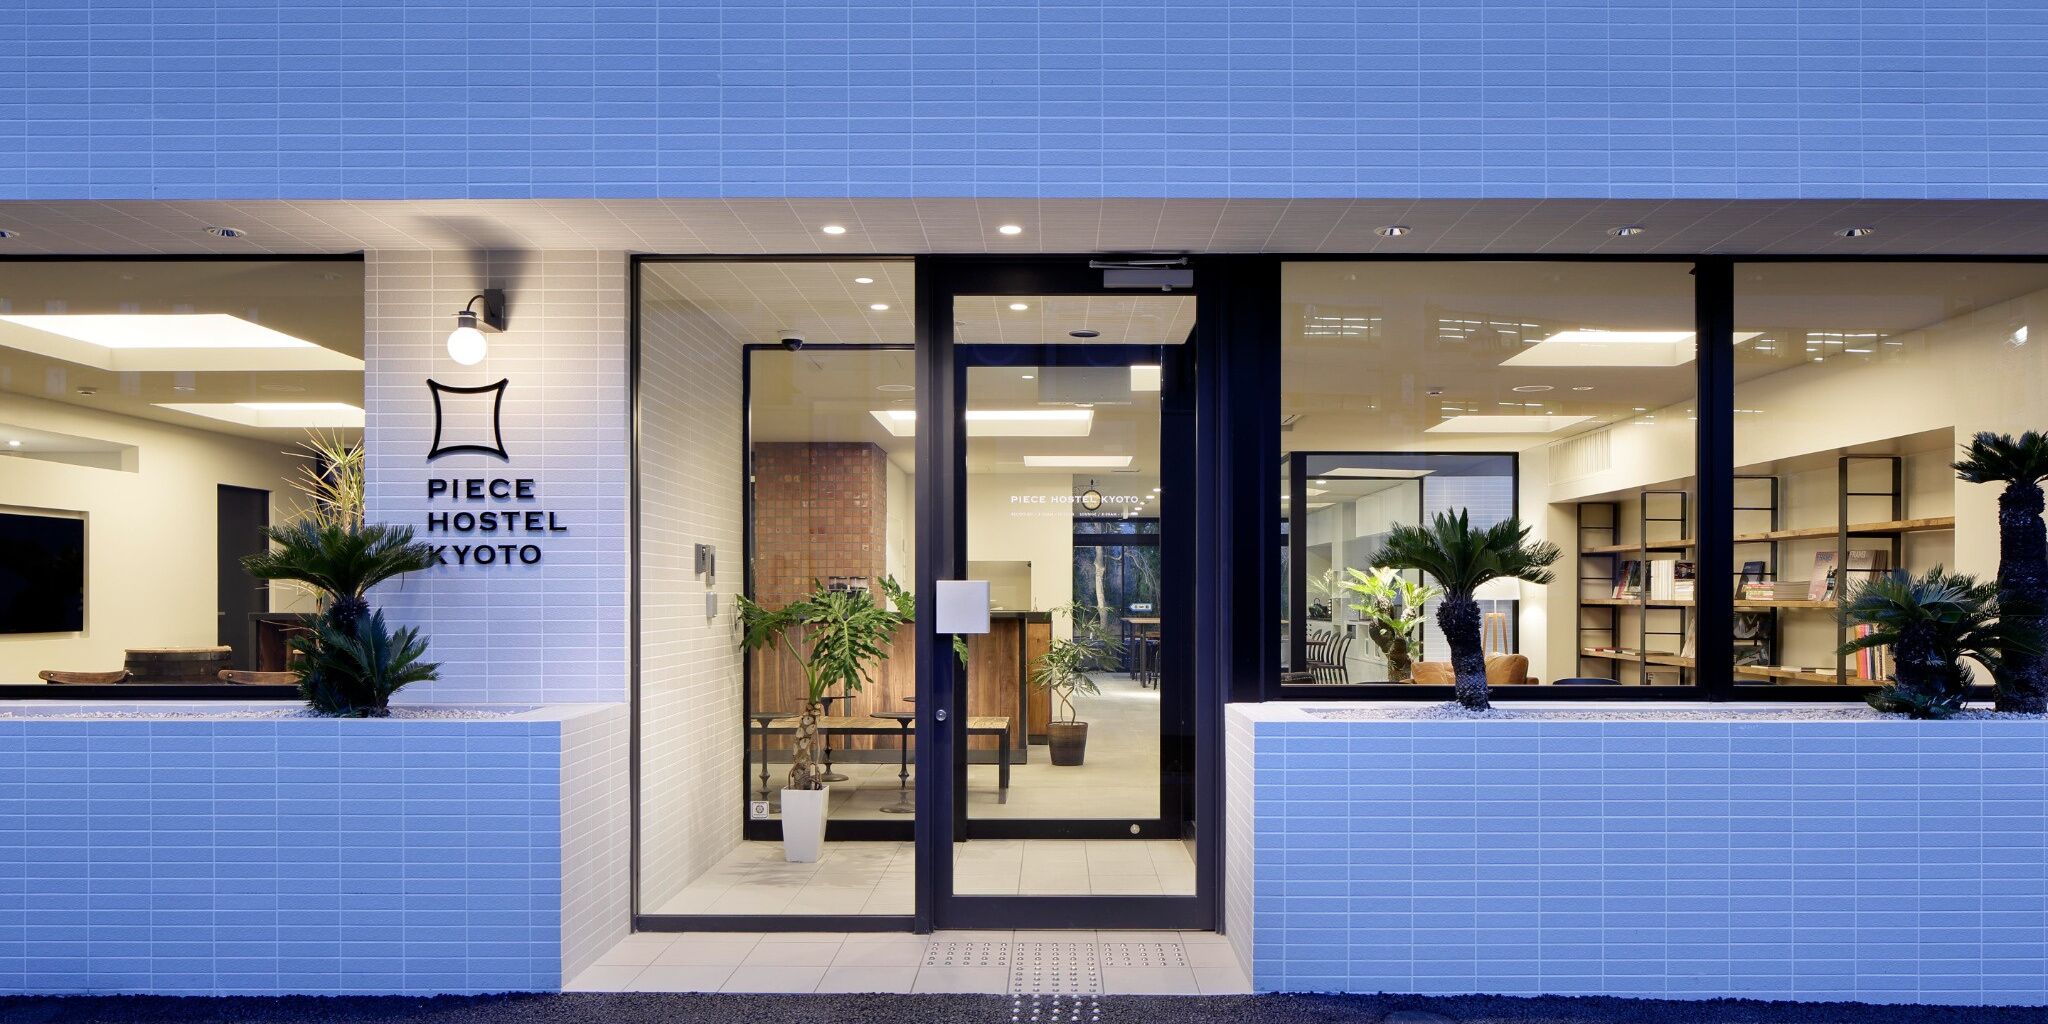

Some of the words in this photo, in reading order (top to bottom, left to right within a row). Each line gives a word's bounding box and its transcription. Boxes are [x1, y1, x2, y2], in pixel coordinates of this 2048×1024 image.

[427, 478, 535, 499] PIECE
[1010, 495, 1046, 504] PIECE
[1051, 495, 1097, 504] HOSTEL
[1101, 495, 1139, 504] KYOTO
[427, 511, 568, 531] HOSTEL
[428, 544, 542, 565] KYOTO
